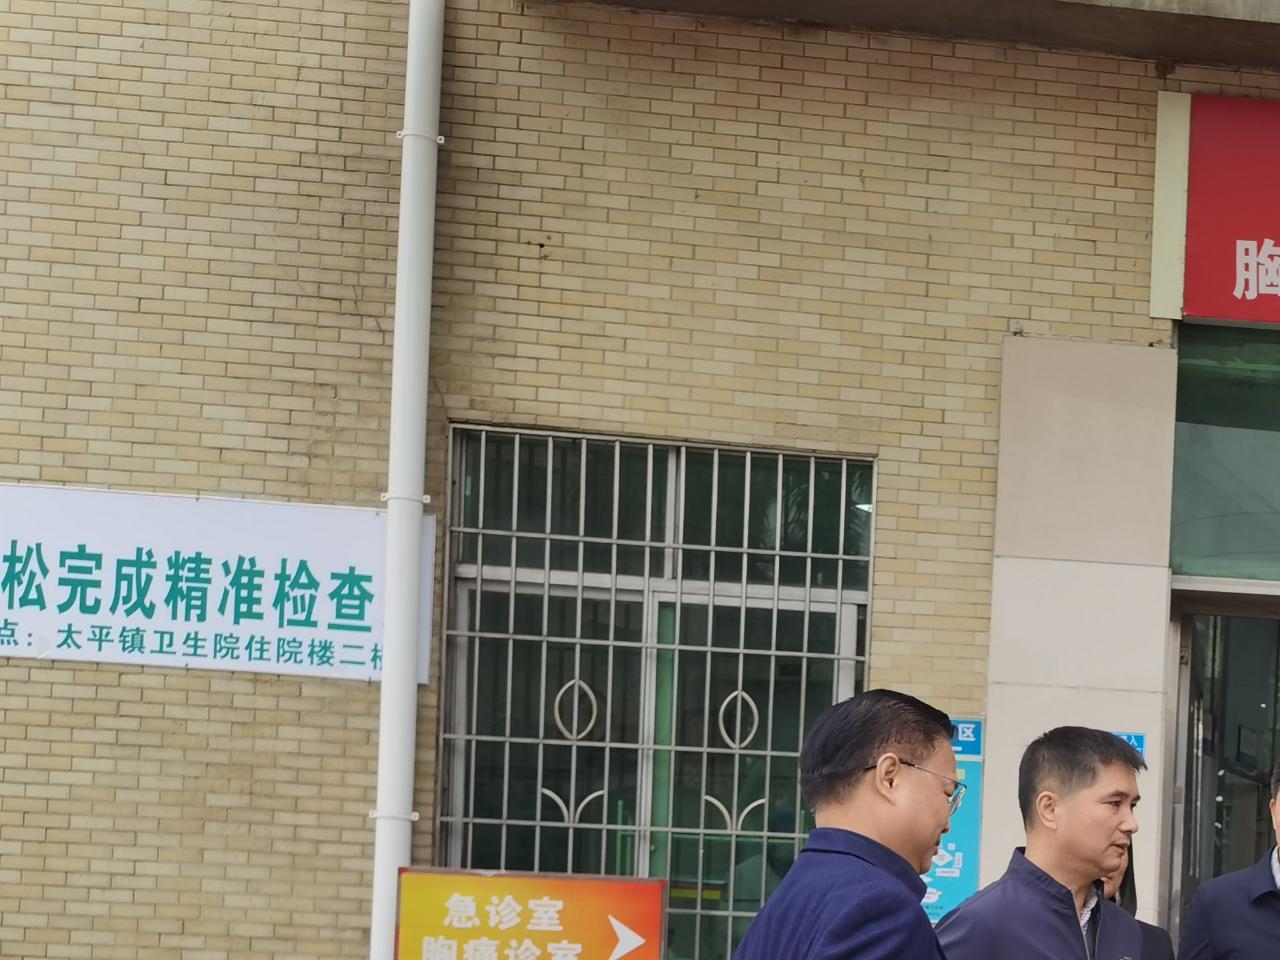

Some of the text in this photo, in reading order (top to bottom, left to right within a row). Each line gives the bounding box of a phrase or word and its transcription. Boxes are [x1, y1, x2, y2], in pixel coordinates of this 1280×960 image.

[1, 539, 375, 633] 松完成精准检查
[443, 892, 564, 932] 急诊室
